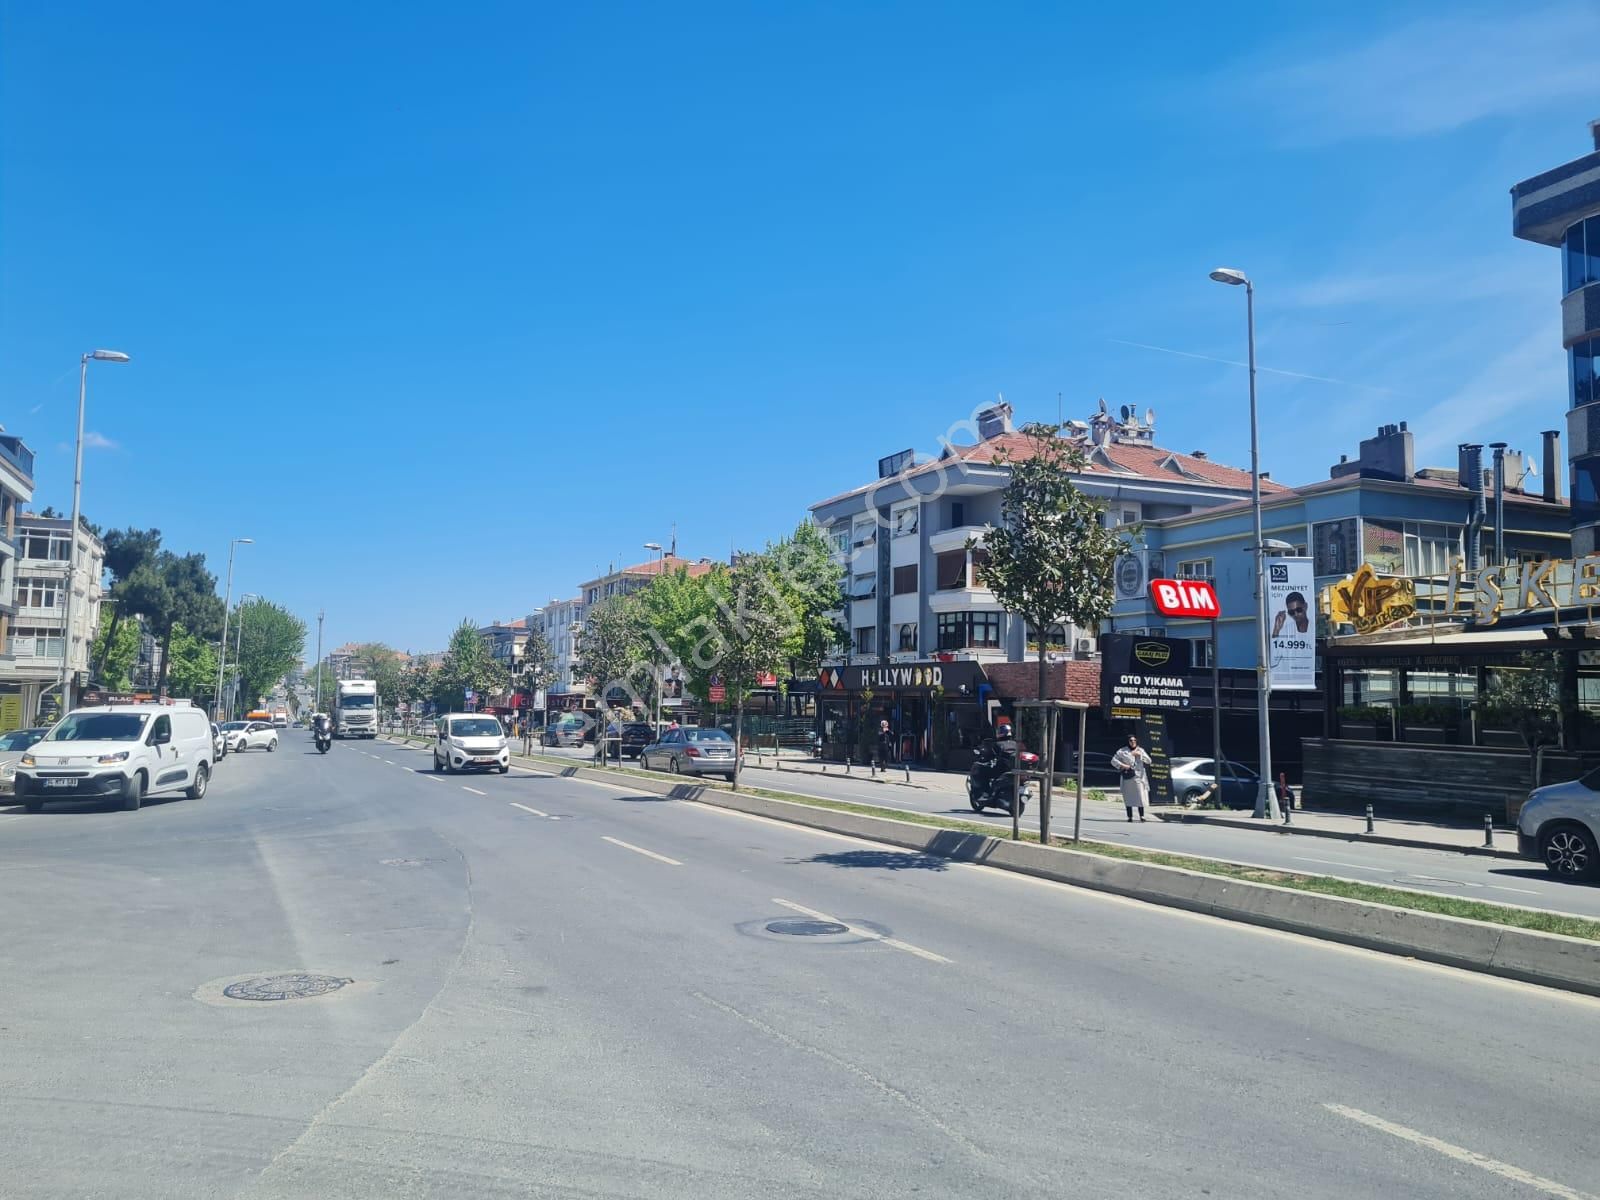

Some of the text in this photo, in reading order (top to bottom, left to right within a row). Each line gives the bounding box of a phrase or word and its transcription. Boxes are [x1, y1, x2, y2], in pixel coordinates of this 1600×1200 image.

[1158, 580, 1215, 610] BİM
[1273, 641, 1305, 649] 14.999
[1120, 675, 1183, 687] OTO YIKAMA
